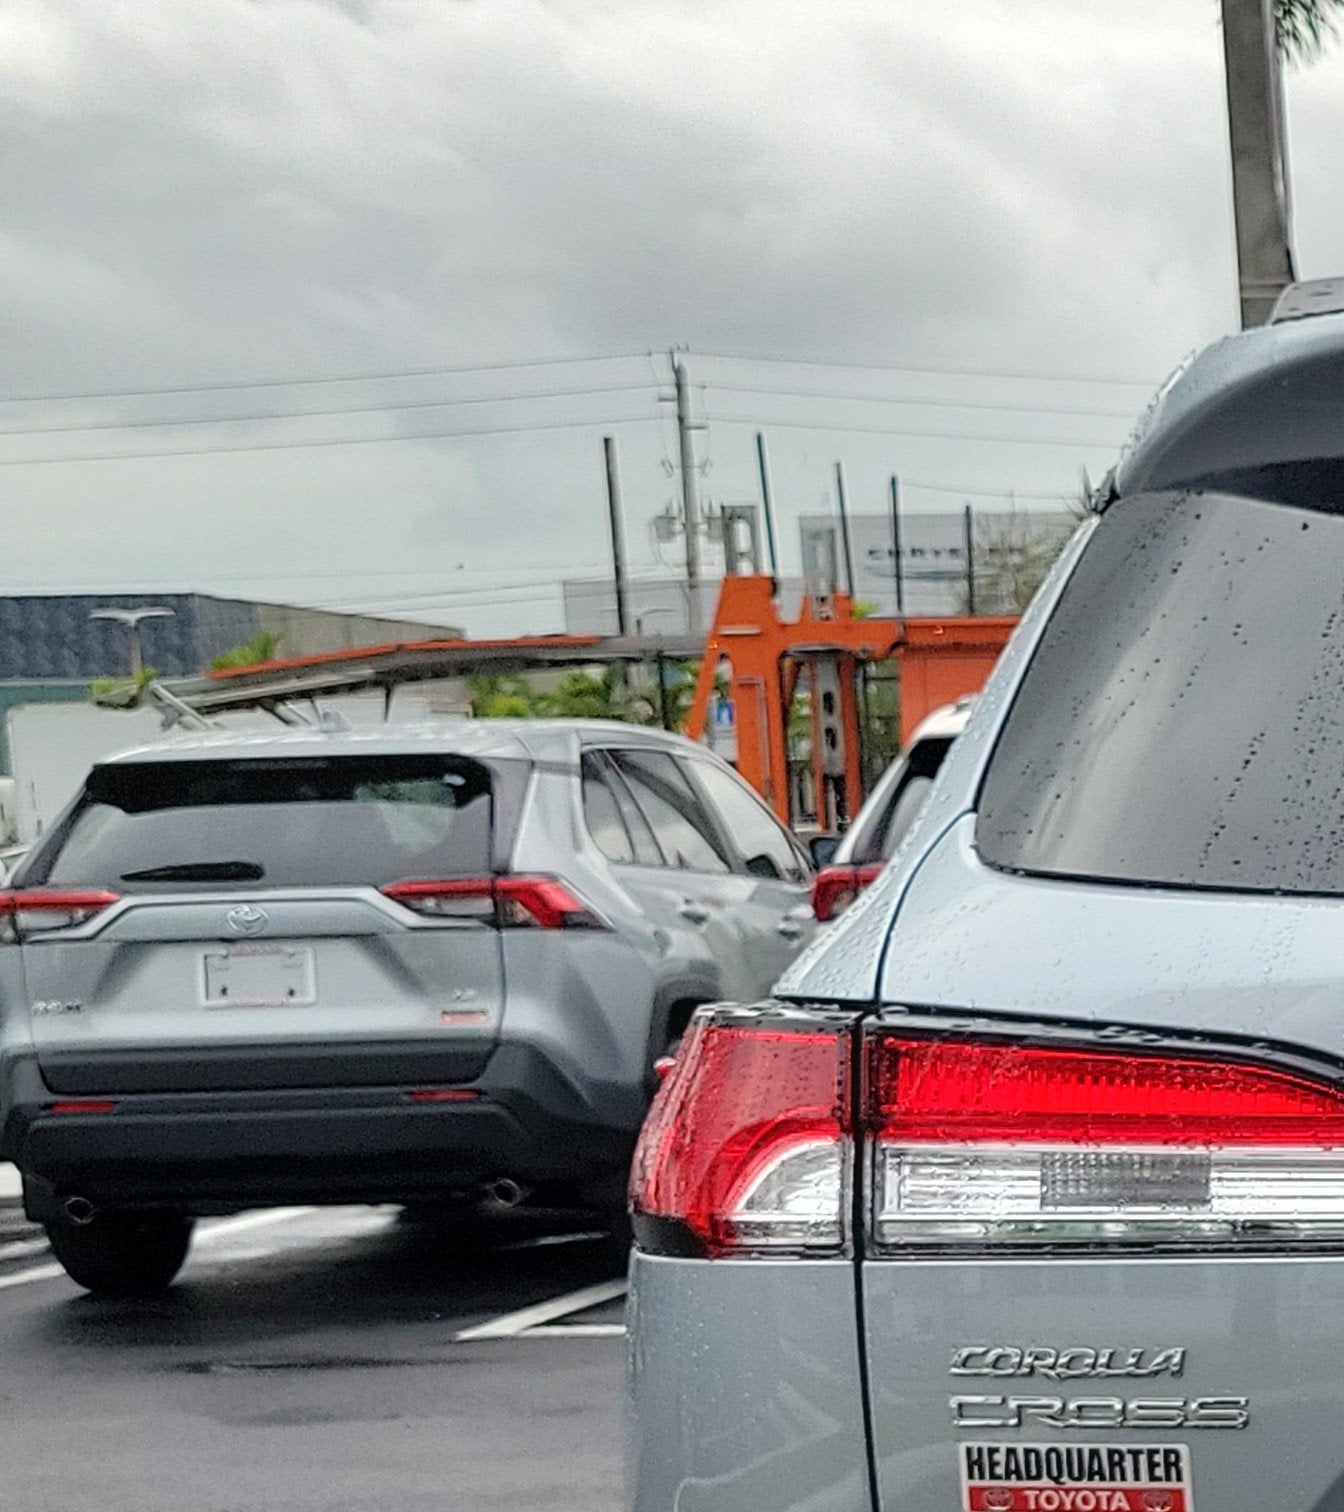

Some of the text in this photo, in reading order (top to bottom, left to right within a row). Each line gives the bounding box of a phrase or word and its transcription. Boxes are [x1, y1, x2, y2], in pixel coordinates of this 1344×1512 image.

[950, 1347, 1186, 1379] COROLLA
[949, 1396, 1249, 1428] CROSS
[964, 1446, 1184, 1484] HEADQUARTER
[1023, 1490, 1130, 1512] TOYOTA
